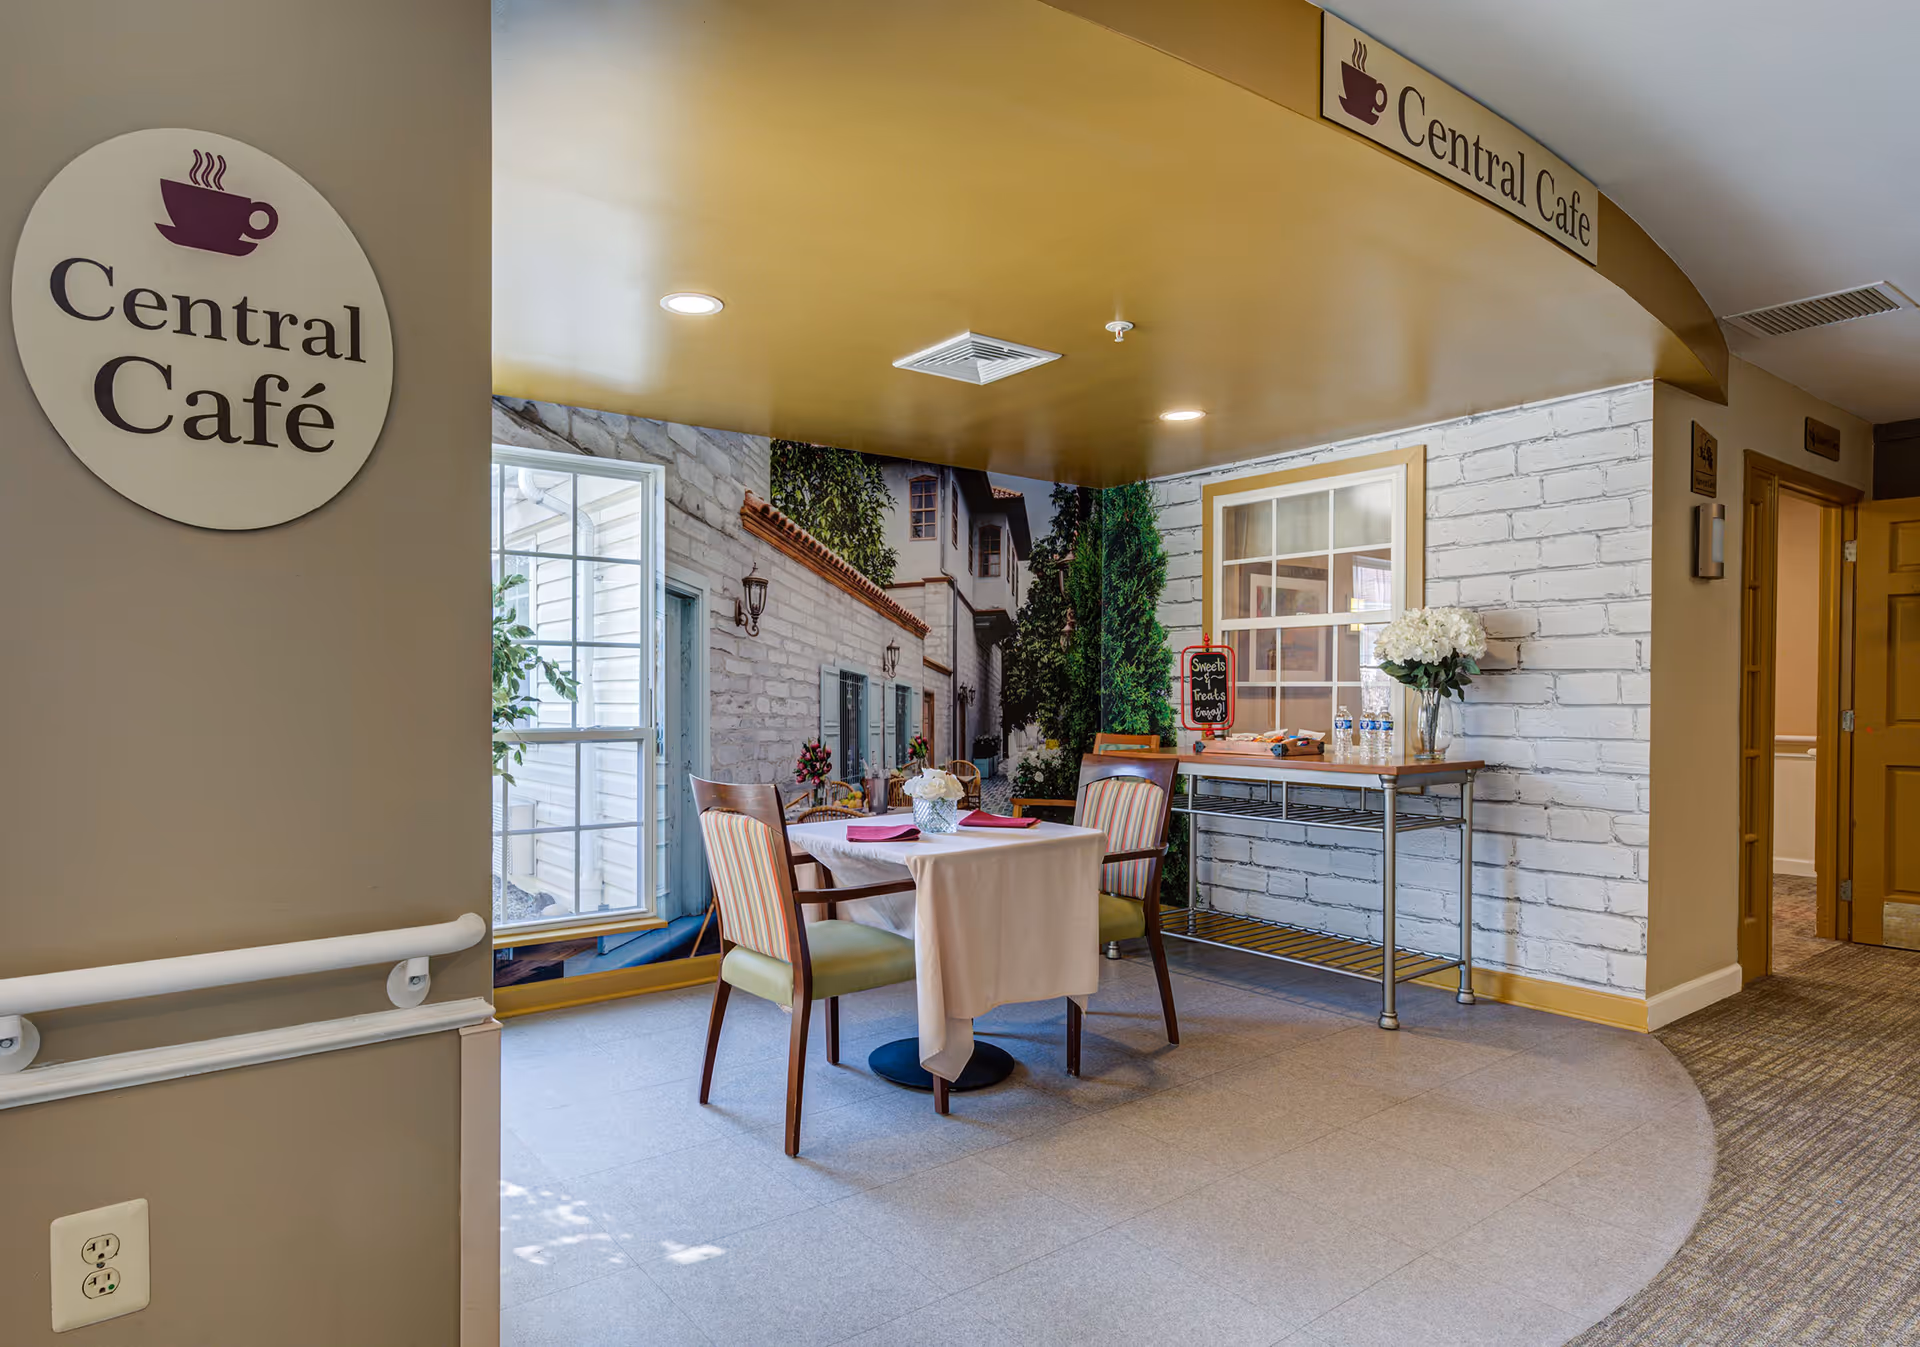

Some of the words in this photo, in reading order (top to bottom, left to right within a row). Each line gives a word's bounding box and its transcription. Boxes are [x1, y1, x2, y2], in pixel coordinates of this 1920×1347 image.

[1398, 85, 1527, 208] Central
[1536, 168, 1591, 248] Cafe
[49, 256, 367, 363] Central
[93, 354, 335, 453] Café
[1191, 658, 1226, 672] Sweets
[1192, 688, 1226, 701] Treats
[1195, 702, 1226, 721] Enjoy!
